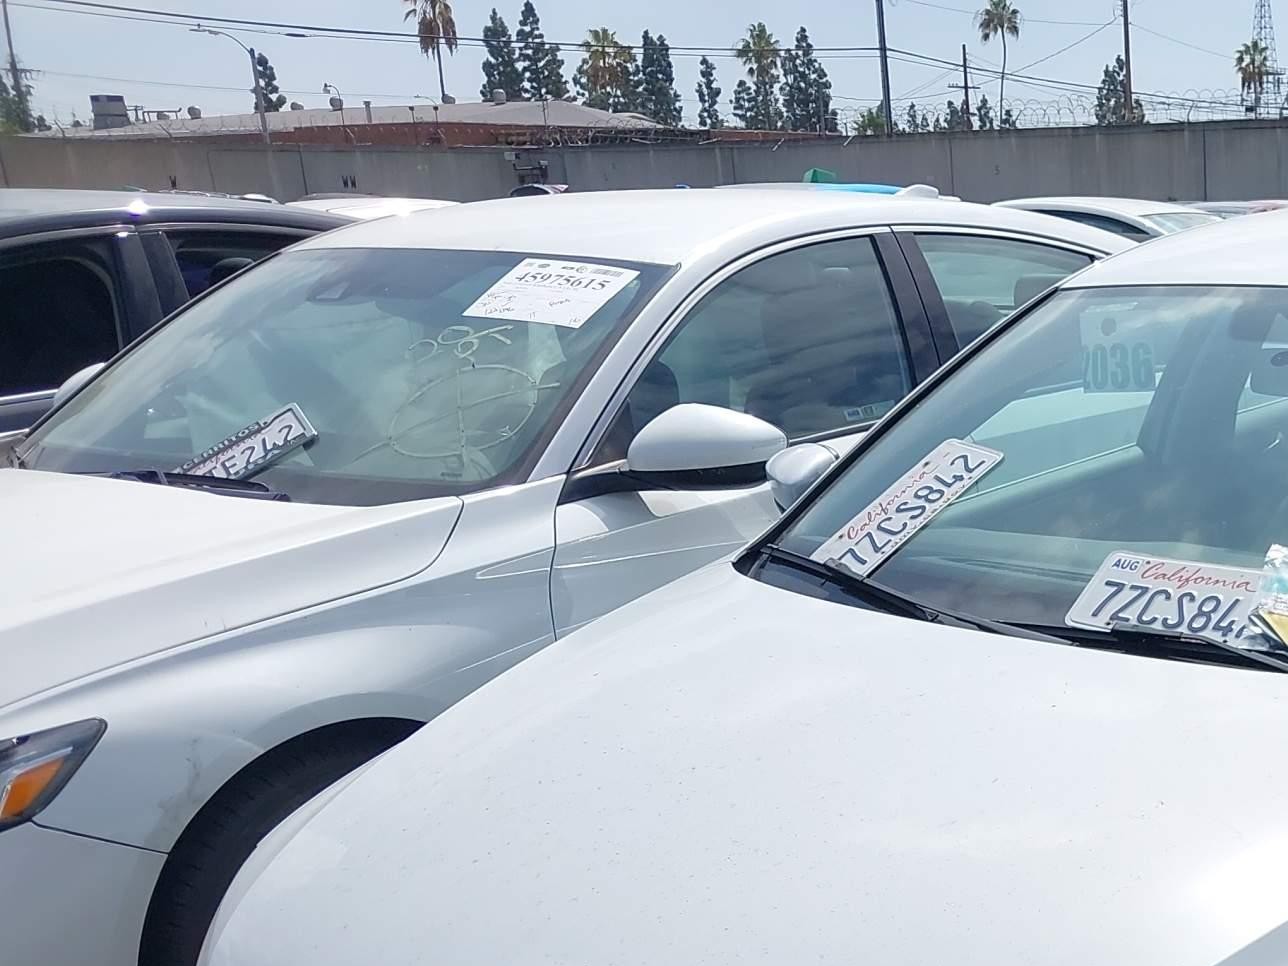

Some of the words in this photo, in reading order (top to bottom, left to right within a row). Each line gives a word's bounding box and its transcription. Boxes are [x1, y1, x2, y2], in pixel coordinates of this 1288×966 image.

[515, 272, 611, 291] 45975615
[838, 453, 986, 566] 7ZCS842
[847, 463, 940, 540] California
[1112, 557, 1141, 572] AUG
[1140, 561, 1257, 593] California
